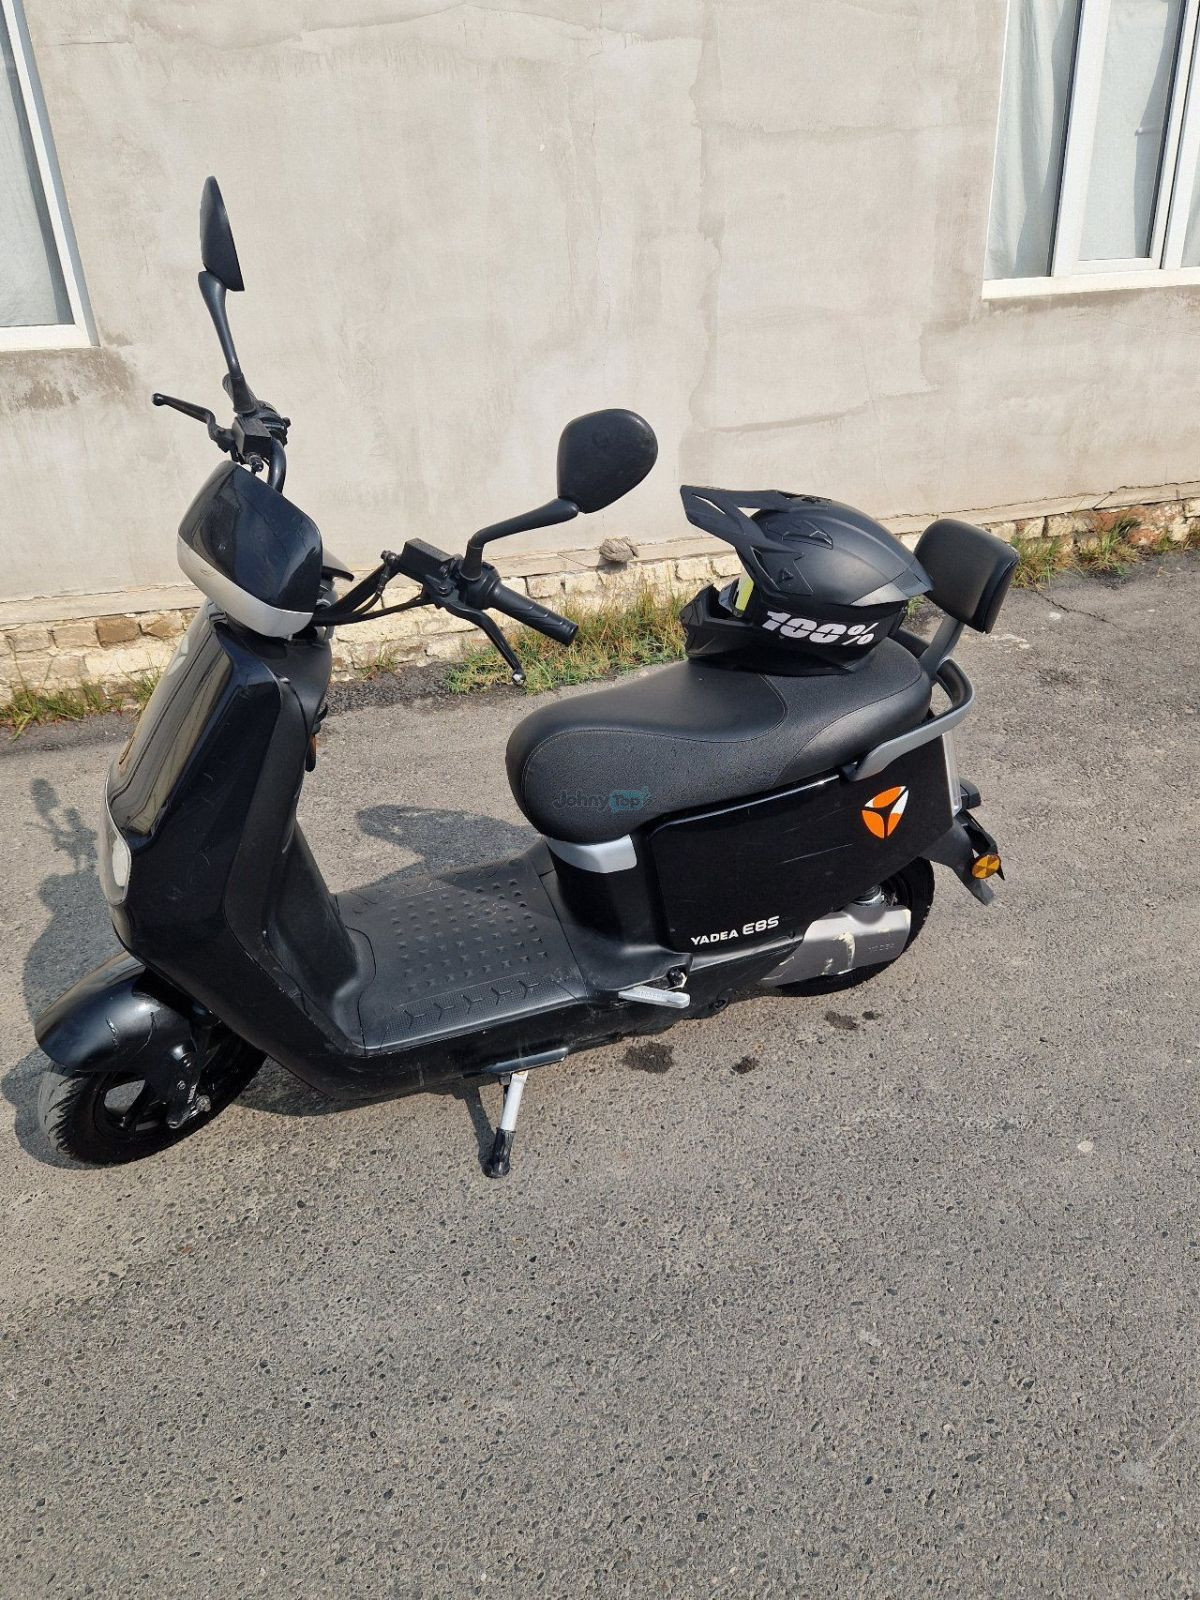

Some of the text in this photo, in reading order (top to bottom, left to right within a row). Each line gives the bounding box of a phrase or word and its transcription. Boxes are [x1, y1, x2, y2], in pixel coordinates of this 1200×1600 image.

[762, 611, 880, 646] 100%
[690, 915, 780, 946] YADEA E8S
